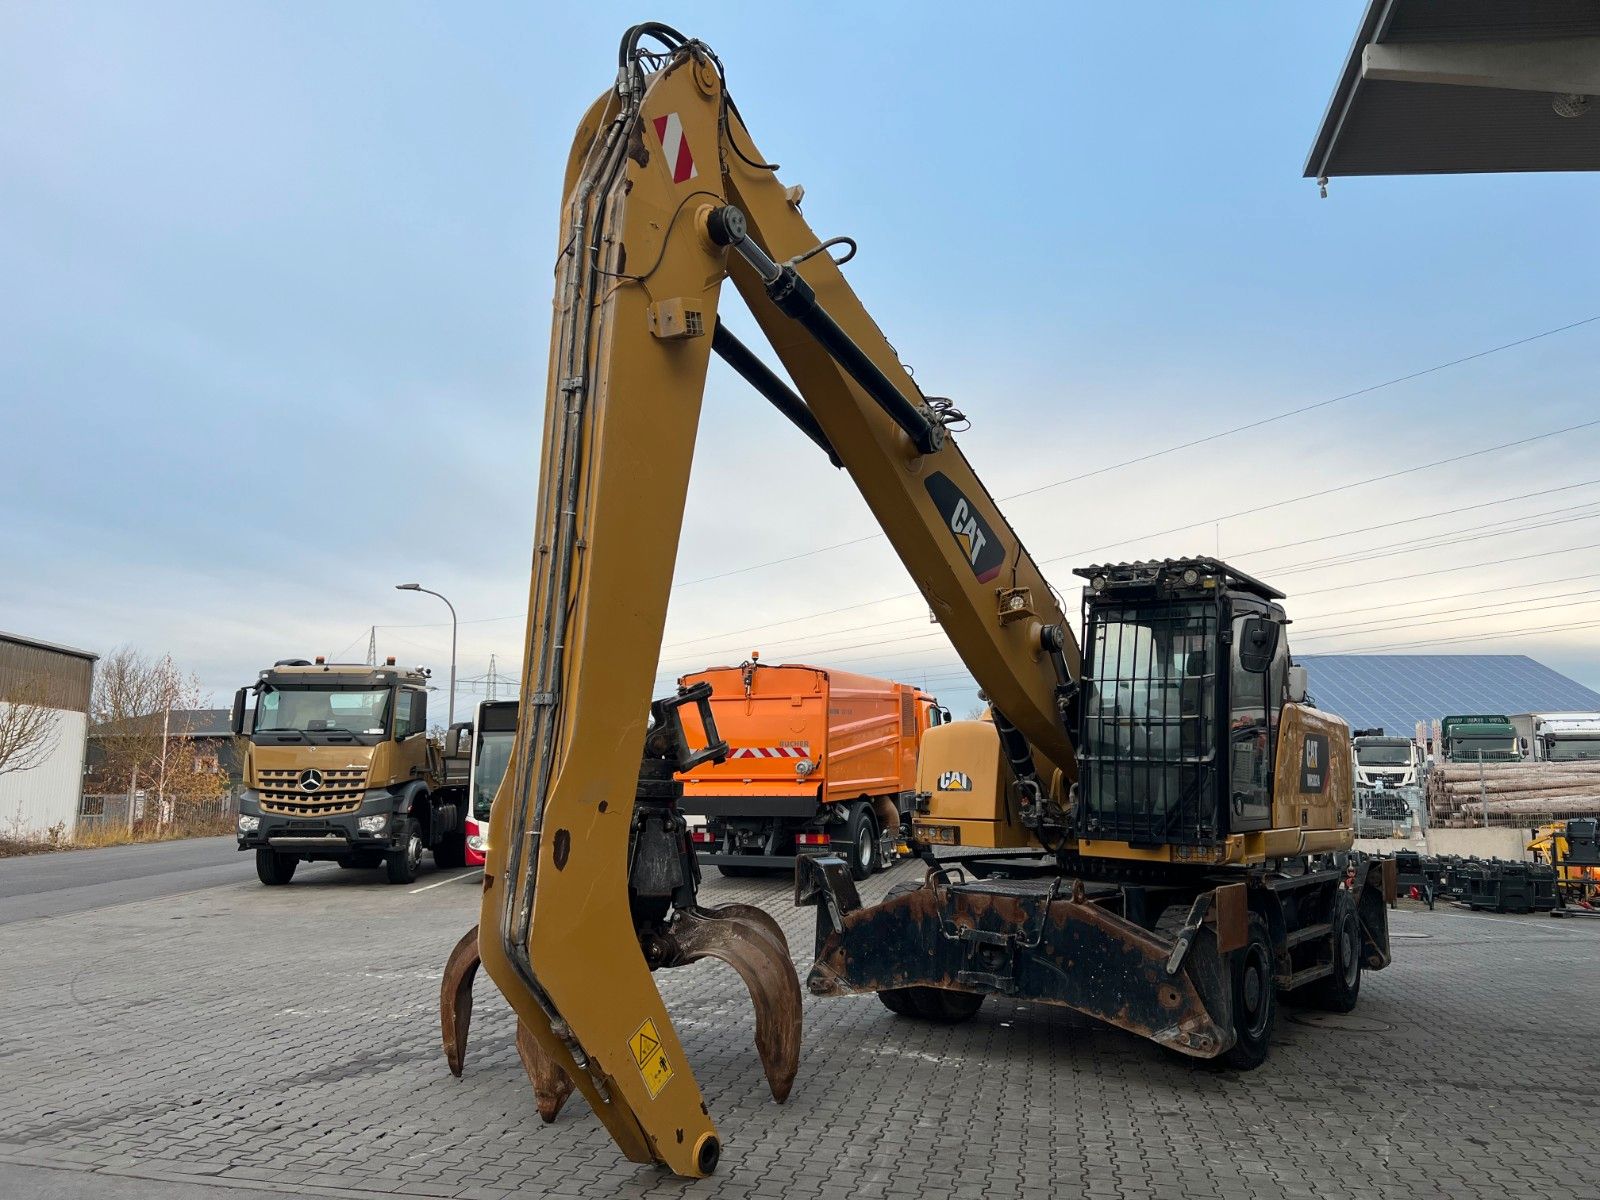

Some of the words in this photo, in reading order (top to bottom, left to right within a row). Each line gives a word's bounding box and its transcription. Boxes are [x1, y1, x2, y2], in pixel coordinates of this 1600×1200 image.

[951, 497, 987, 566] CAT
[780, 740, 809, 748] BUCHER
[1306, 739, 1319, 769] CAT
